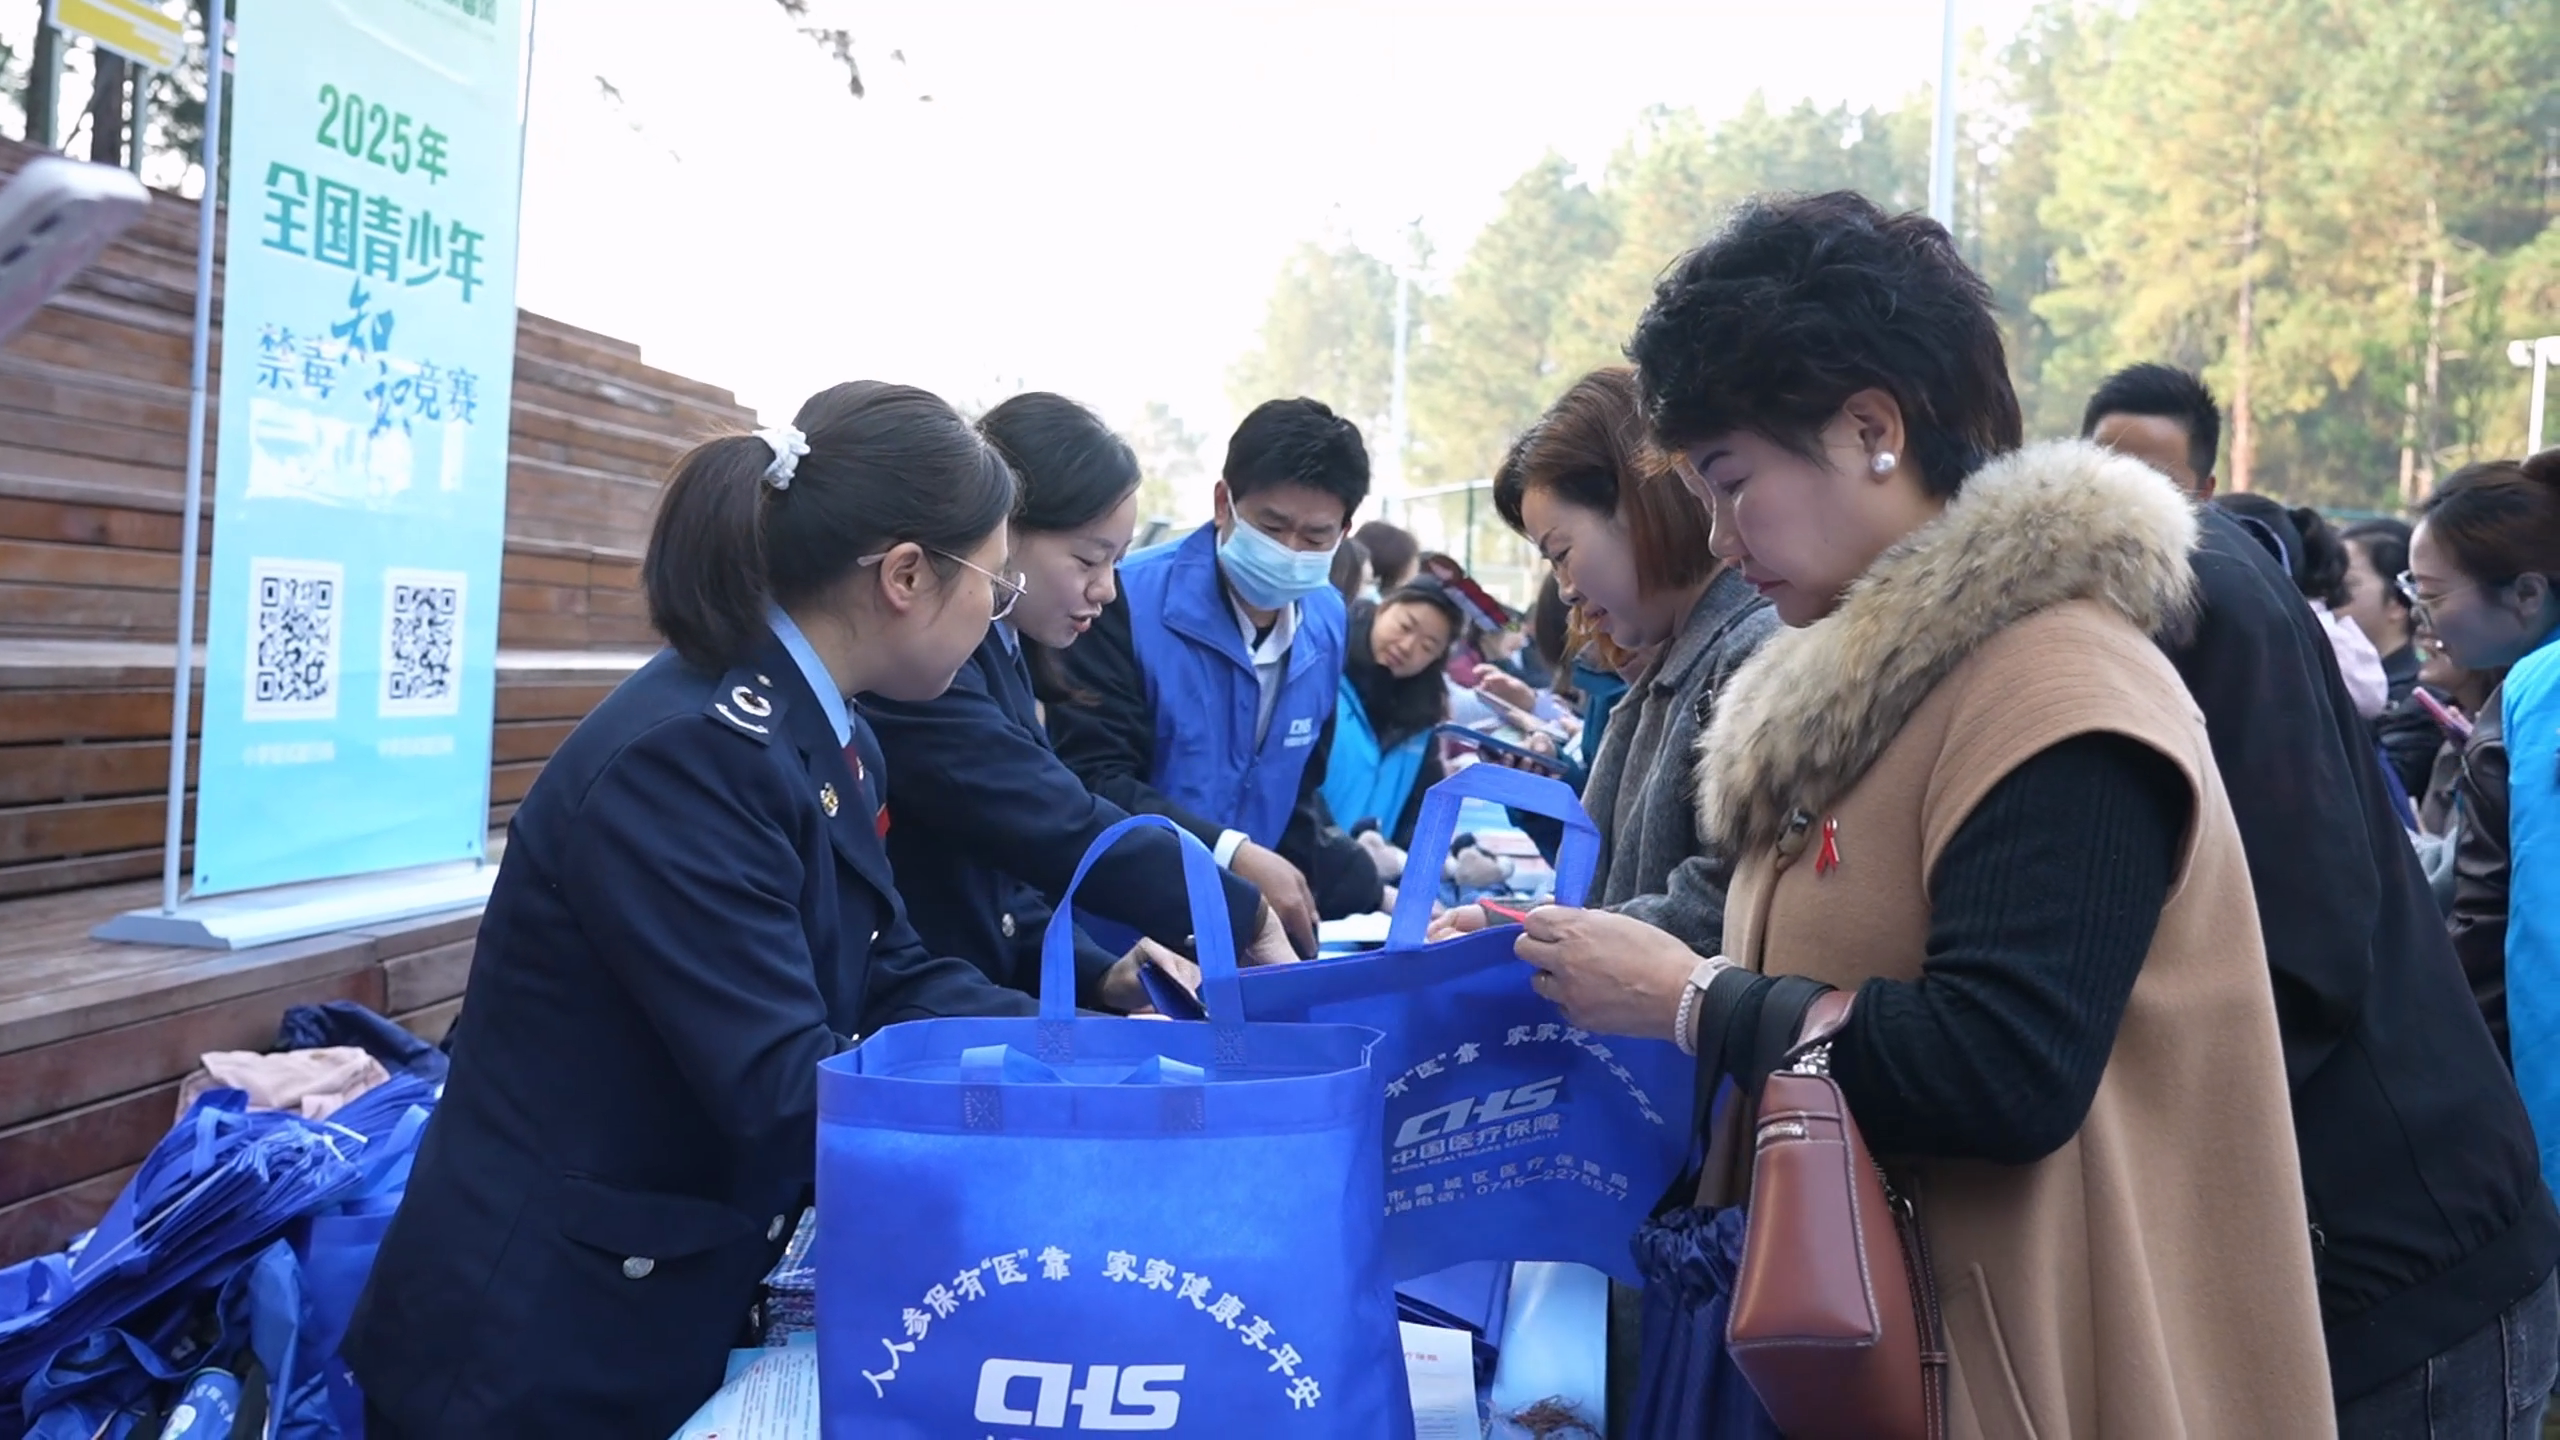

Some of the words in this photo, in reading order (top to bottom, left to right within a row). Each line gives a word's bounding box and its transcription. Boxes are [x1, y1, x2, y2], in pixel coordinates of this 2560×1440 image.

[317, 83, 449, 186] 2025年
[262, 160, 485, 304] 全国青少年
[1391, 1112, 1561, 1166] 中国医疗保障
[1393, 1075, 1564, 1149] CHS
[1101, 1248, 1324, 1412] 家家健康享平安
[973, 1357, 1187, 1431] CHS
